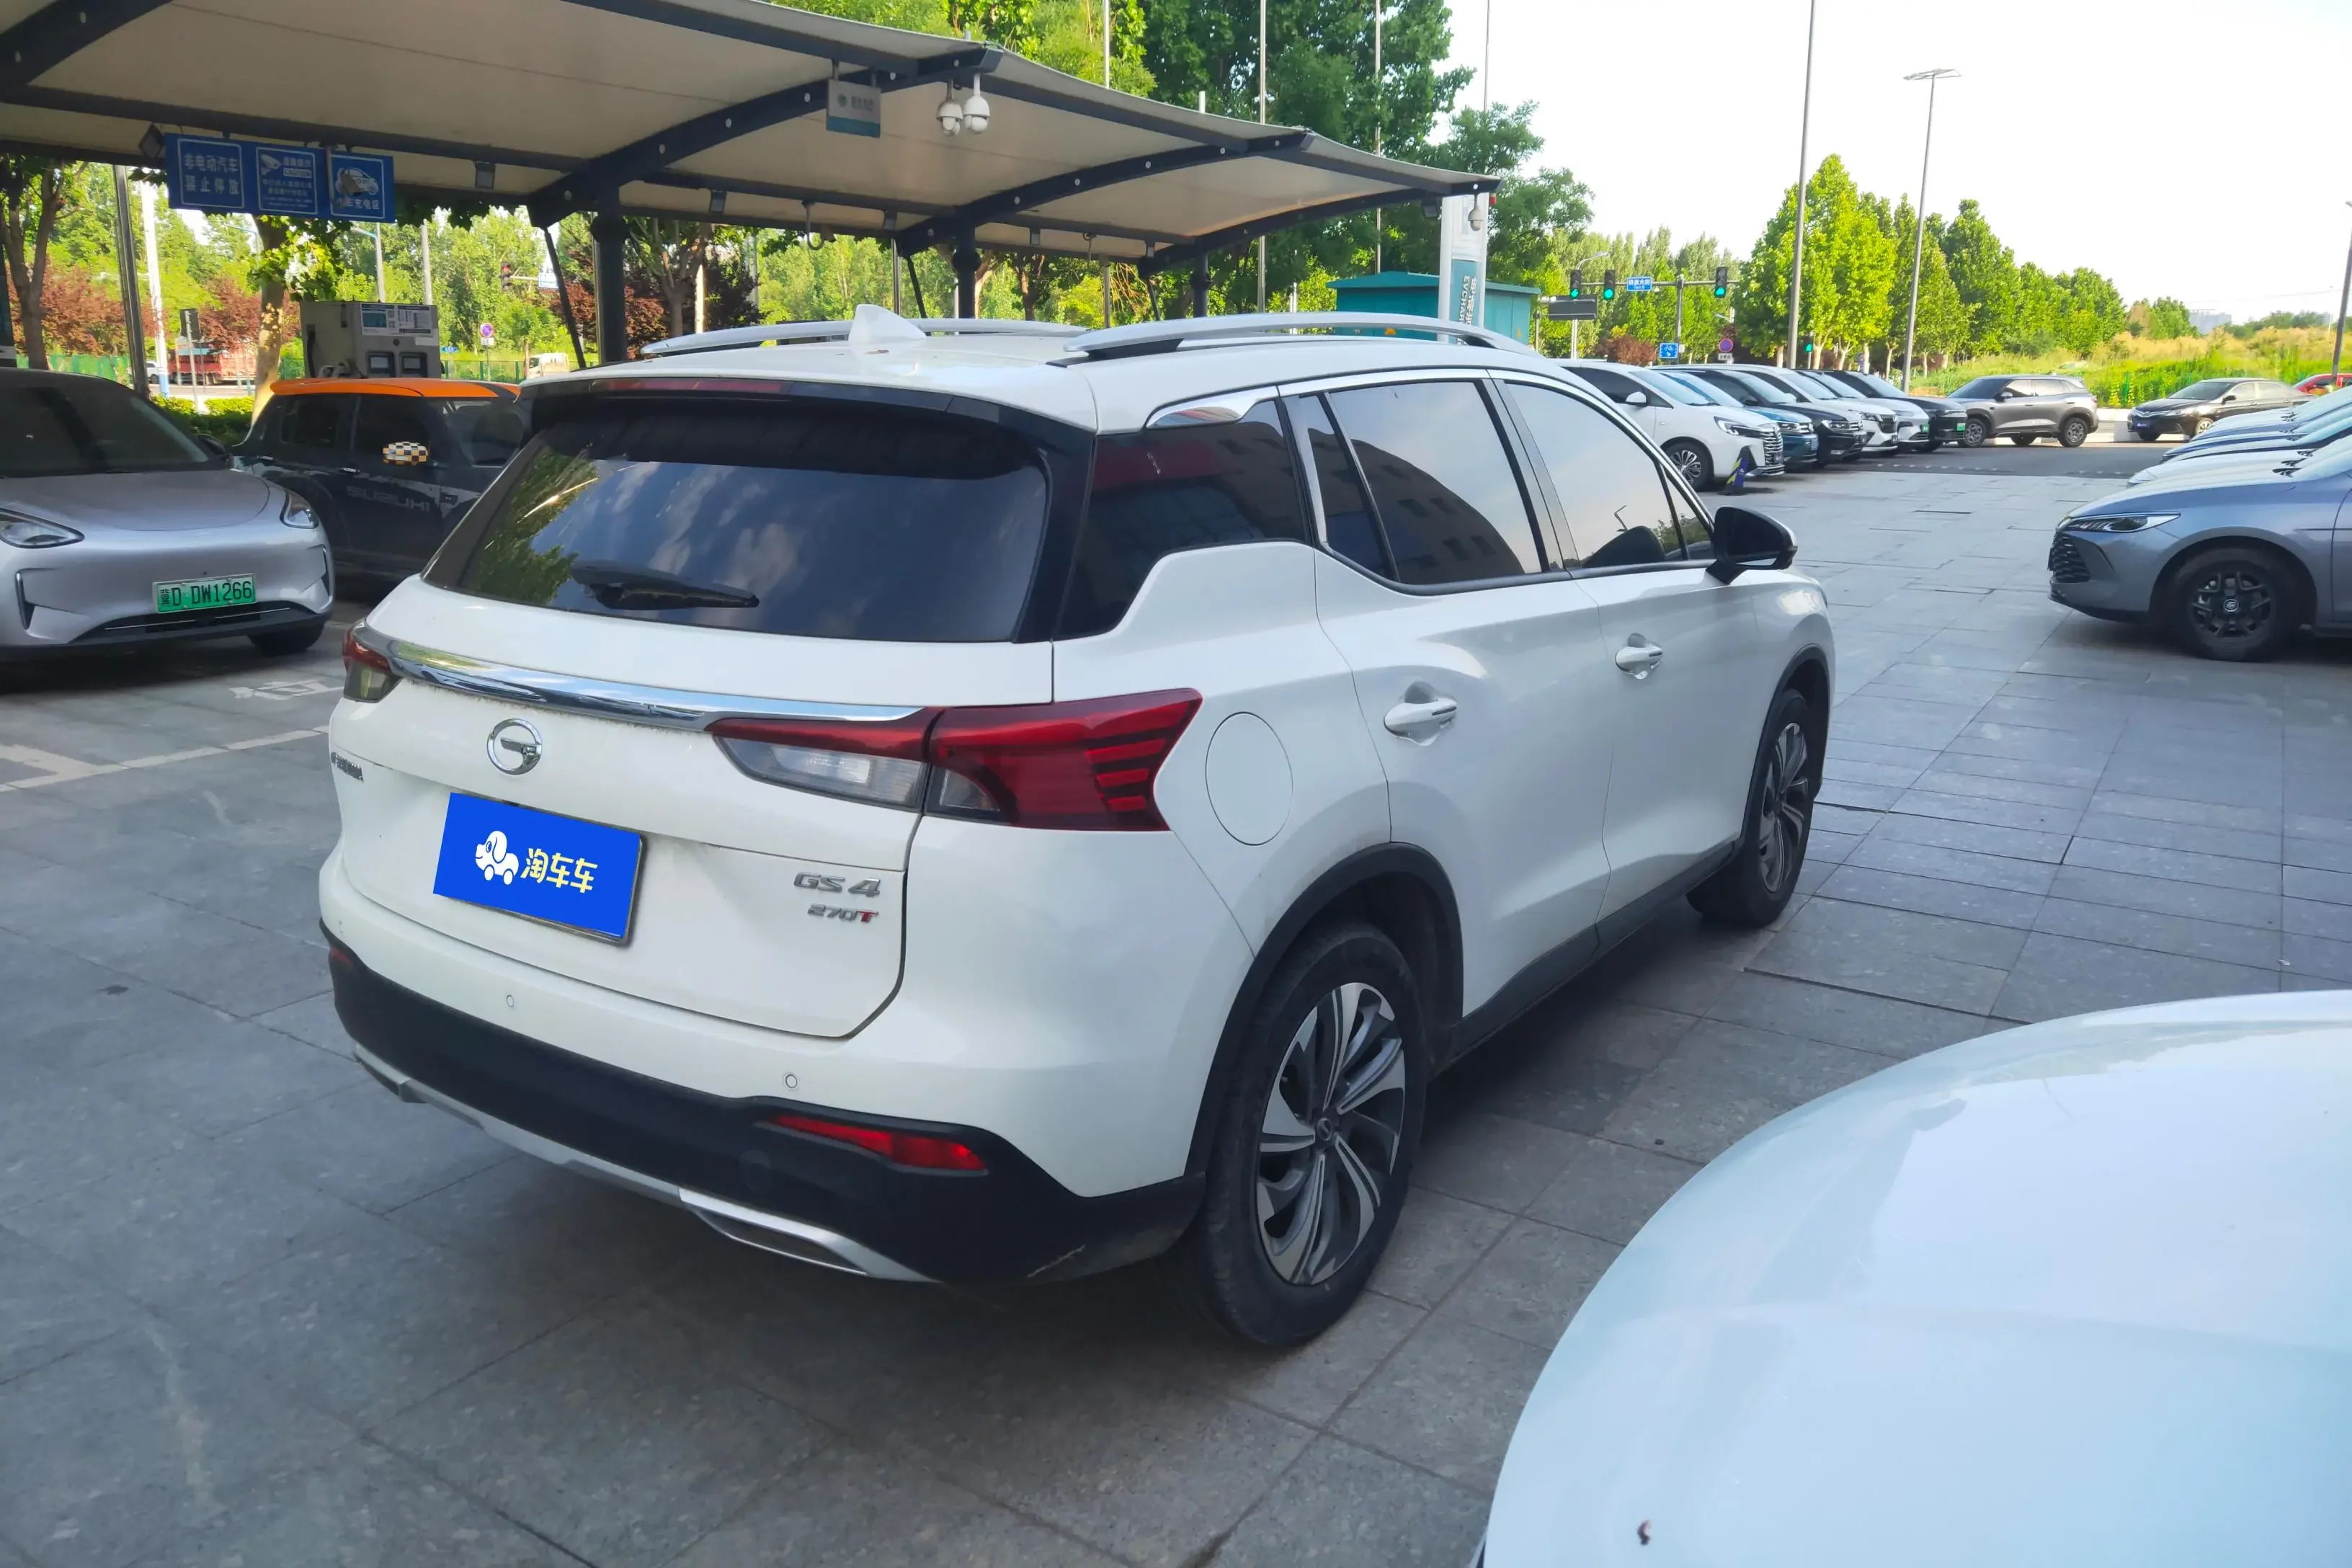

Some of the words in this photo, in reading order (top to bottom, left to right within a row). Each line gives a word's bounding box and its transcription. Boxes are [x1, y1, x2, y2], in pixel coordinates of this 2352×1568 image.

[184, 153, 239, 173] 非电动汽车
[184, 174, 239, 195] 禁止停放
[347, 486, 430, 512] SUZUKI
[807, 904, 879, 923] 270T
